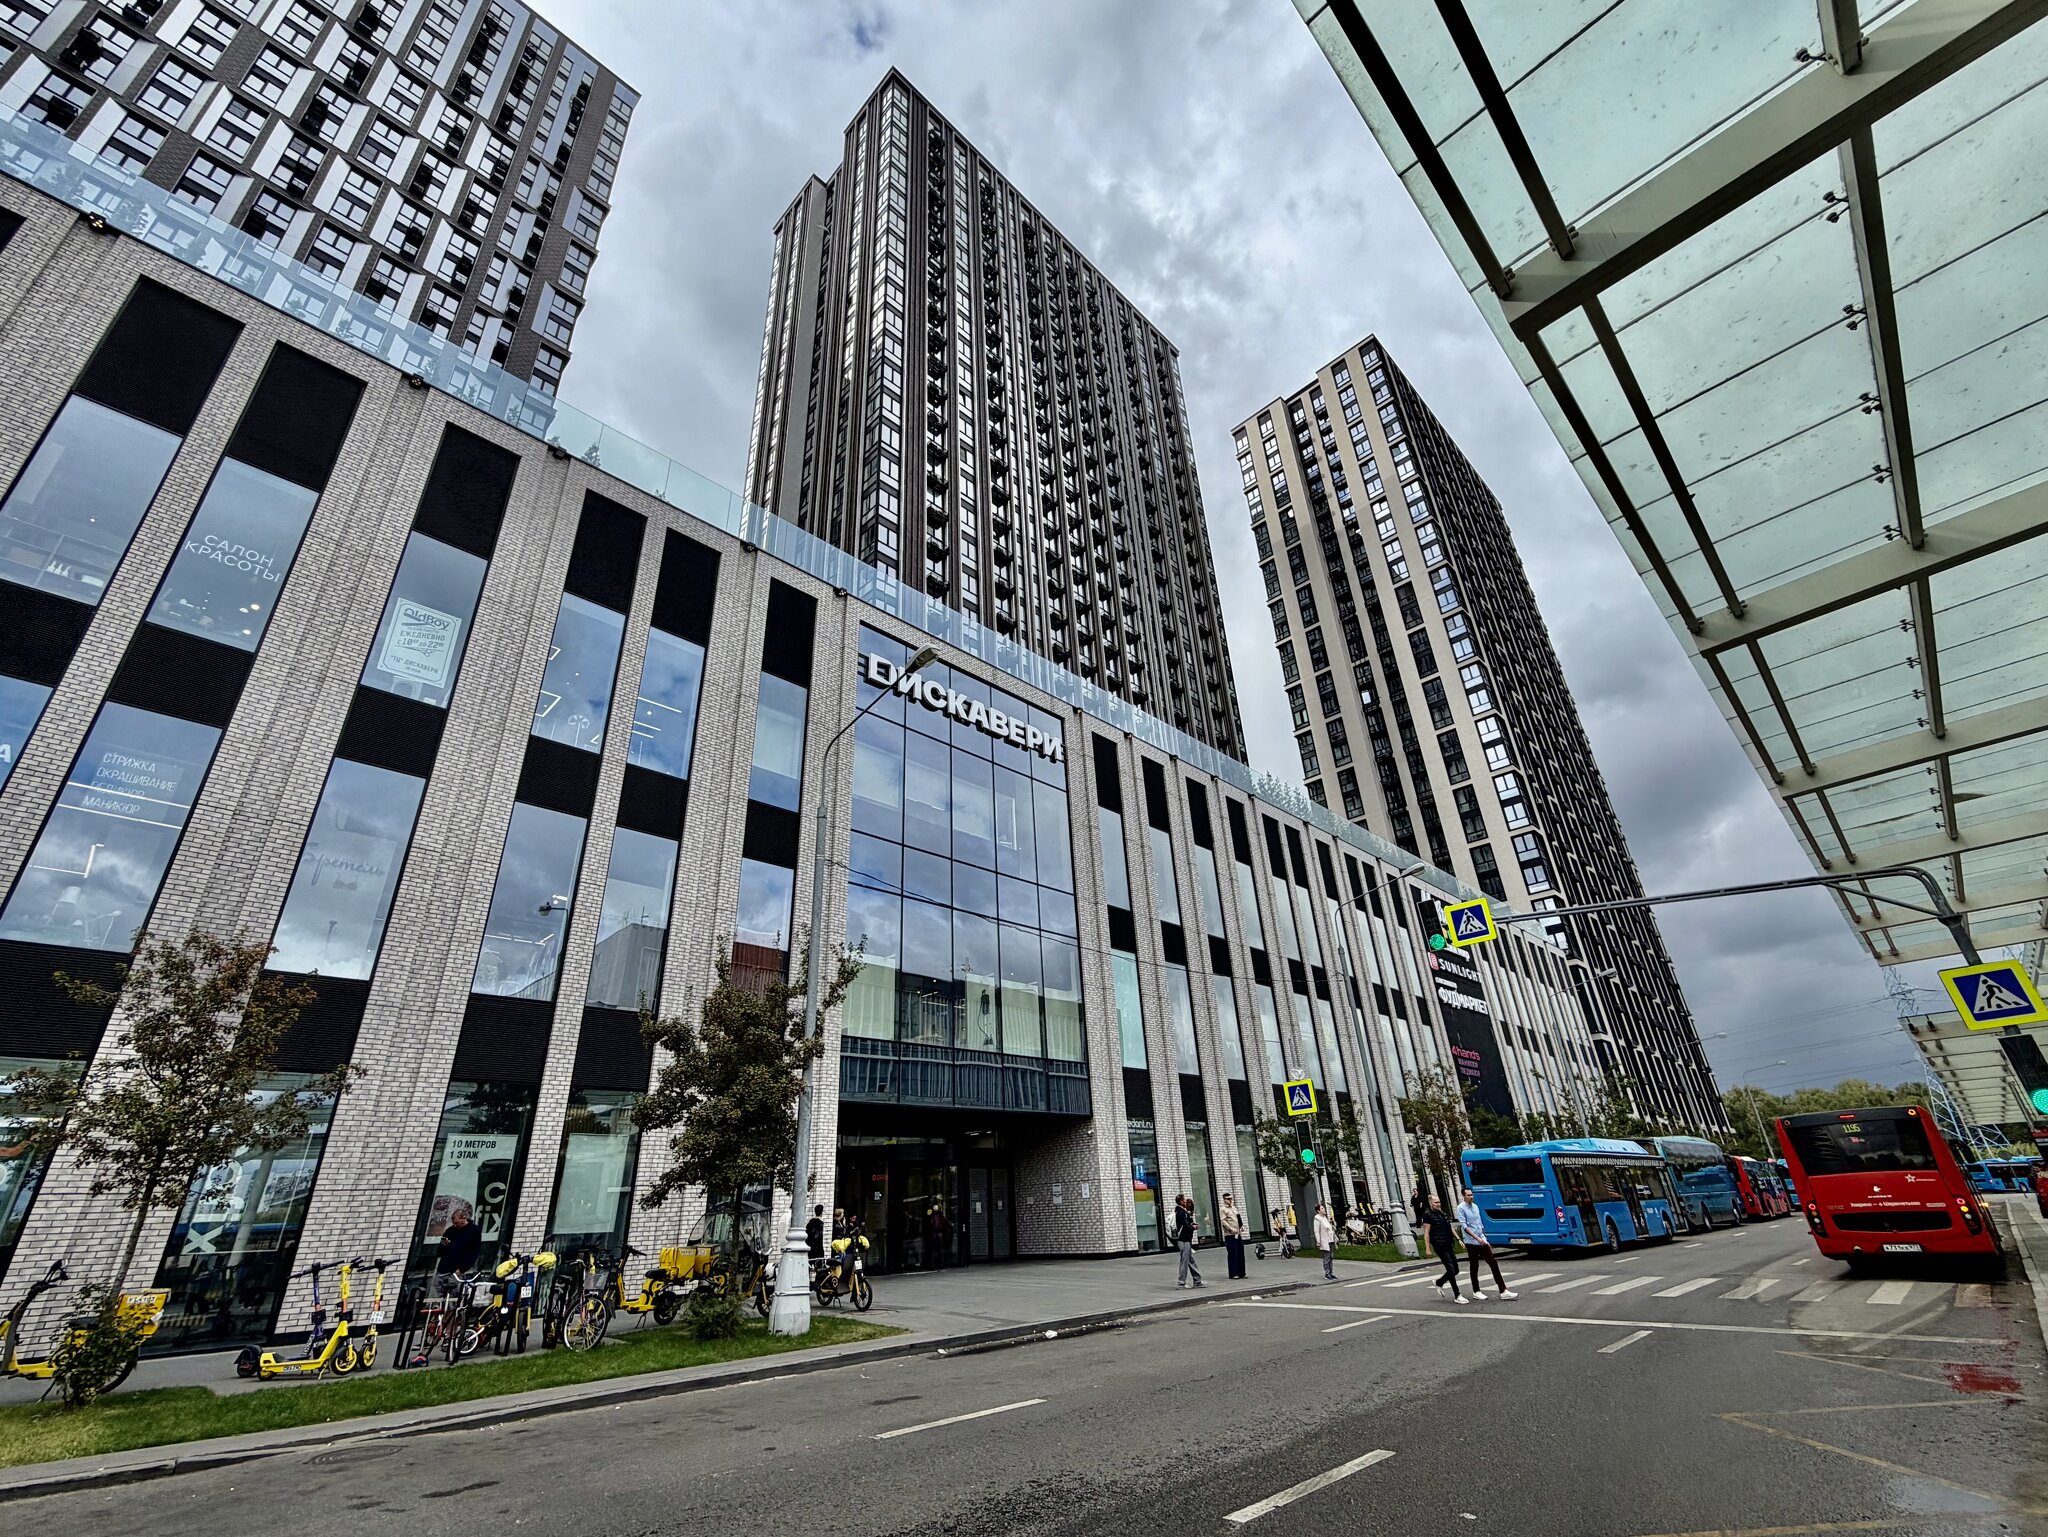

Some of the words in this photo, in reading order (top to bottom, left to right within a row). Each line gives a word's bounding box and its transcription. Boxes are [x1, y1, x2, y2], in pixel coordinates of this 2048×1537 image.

[204, 535, 274, 567] САЛОН
[184, 540, 281, 582] КРАСОТЫ
[400, 630, 446, 641] ЕЖЕДНЕВНО
[103, 752, 156, 772] СТРИЖКА
[96, 767, 178, 792] ОКРАШИВАНИЕ
[82, 795, 141, 814] МАНИКЮР
[1438, 958, 1482, 983] SUNLIGHT
[1437, 986, 1489, 1015] ФУДМАРКЕТ
[1451, 1045, 1480, 1061] 4hands
[1842, 1124, 1861, 1133] 1195
[452, 1140, 463, 1148] 10
[464, 1140, 497, 1149] МЕТРОВ
[450, 1150, 455, 1159] 1
[456, 1150, 480, 1160] ЭТАЖ
